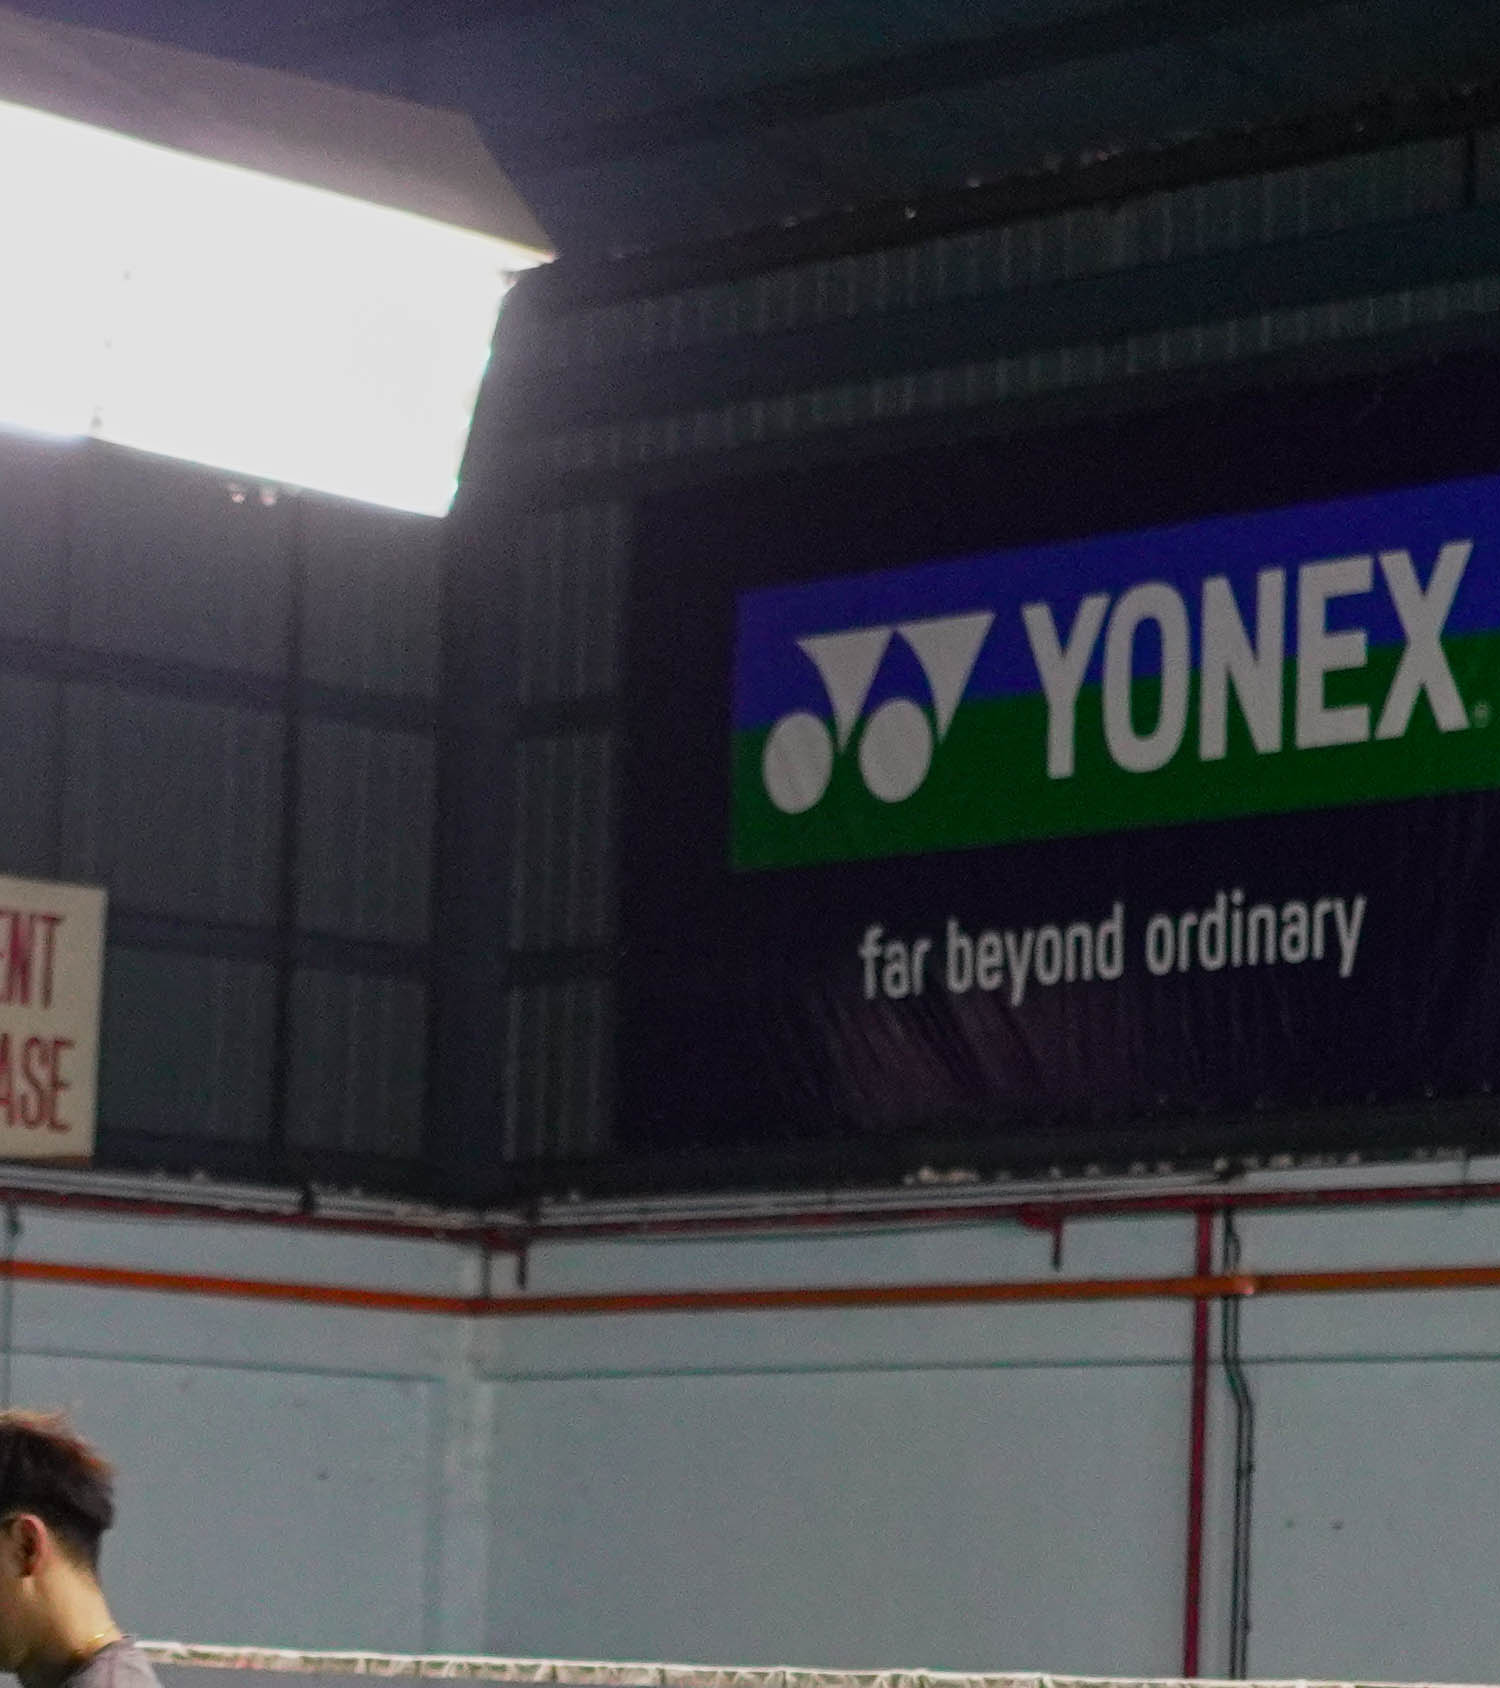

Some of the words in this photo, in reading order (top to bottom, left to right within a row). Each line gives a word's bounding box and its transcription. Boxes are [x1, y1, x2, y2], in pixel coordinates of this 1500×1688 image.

[1023, 540, 1474, 780] YONEX
[858, 925, 930, 1000] far
[945, 901, 1124, 1007] beyond
[1144, 888, 1367, 977] ordinary
